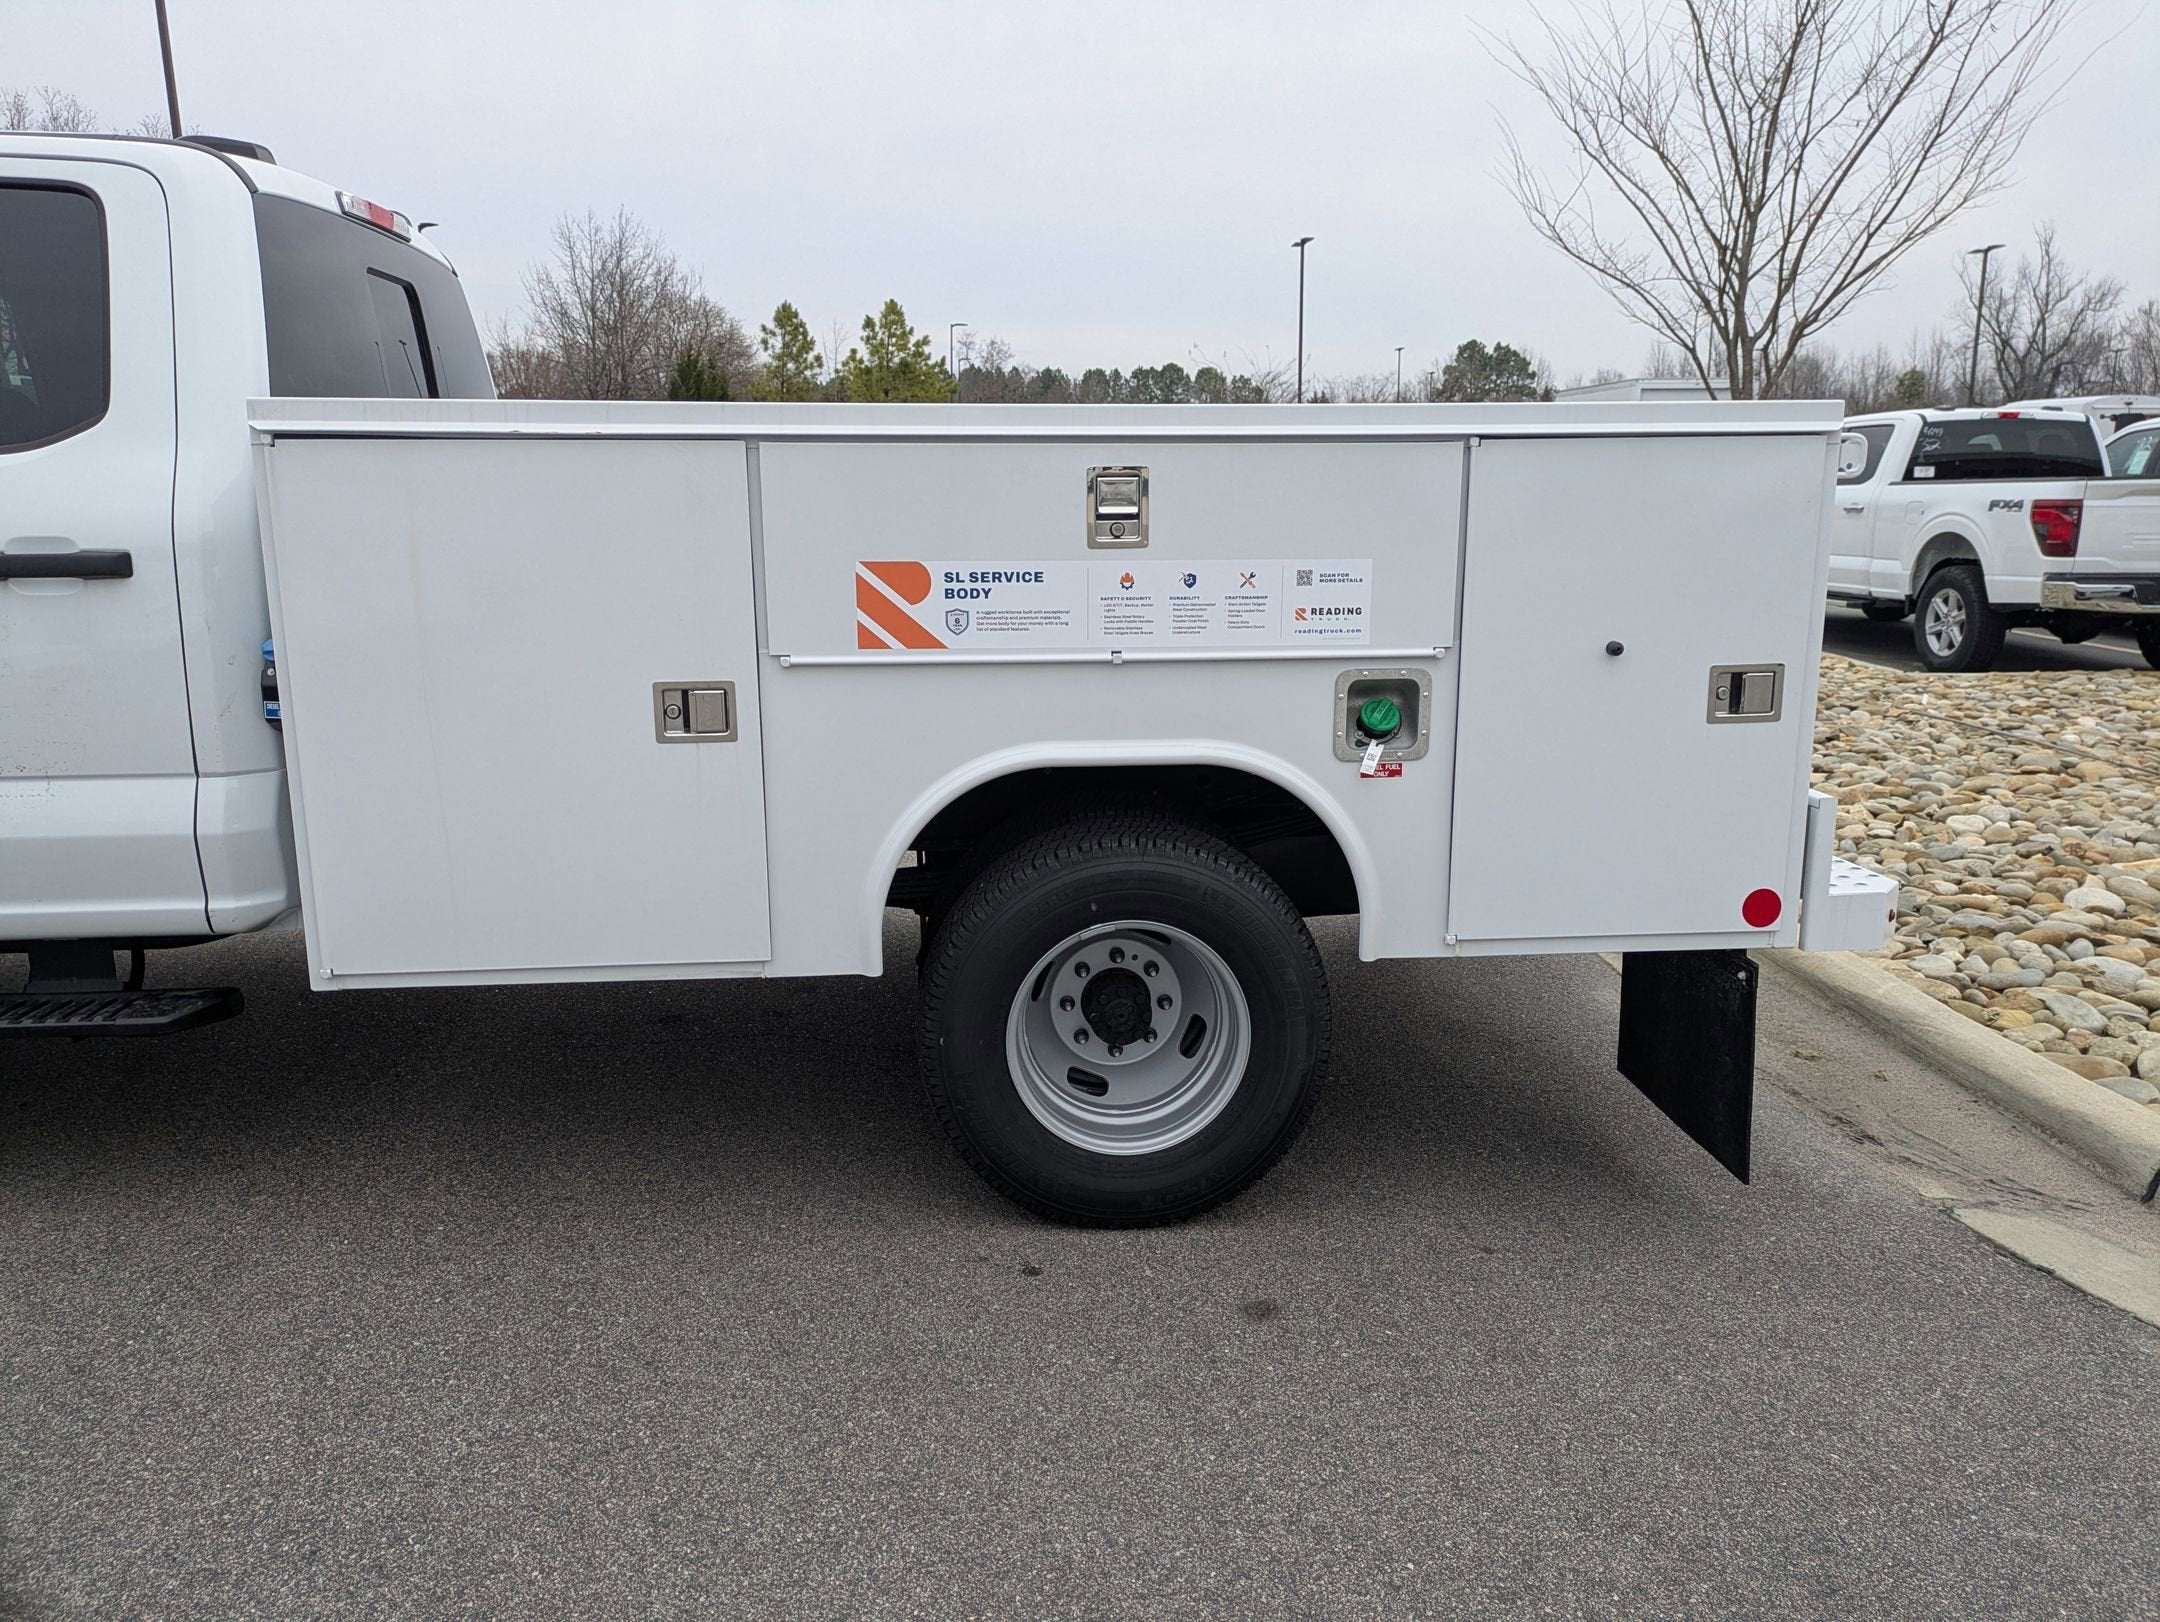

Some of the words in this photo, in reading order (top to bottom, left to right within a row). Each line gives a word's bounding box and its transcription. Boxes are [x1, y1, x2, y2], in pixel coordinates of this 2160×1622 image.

[1988, 500, 2024, 512] FX4
[943, 572, 965, 583] SL
[969, 572, 1044, 583] SERVICE
[944, 588, 992, 599] BODY
[1311, 607, 1362, 616] READING
